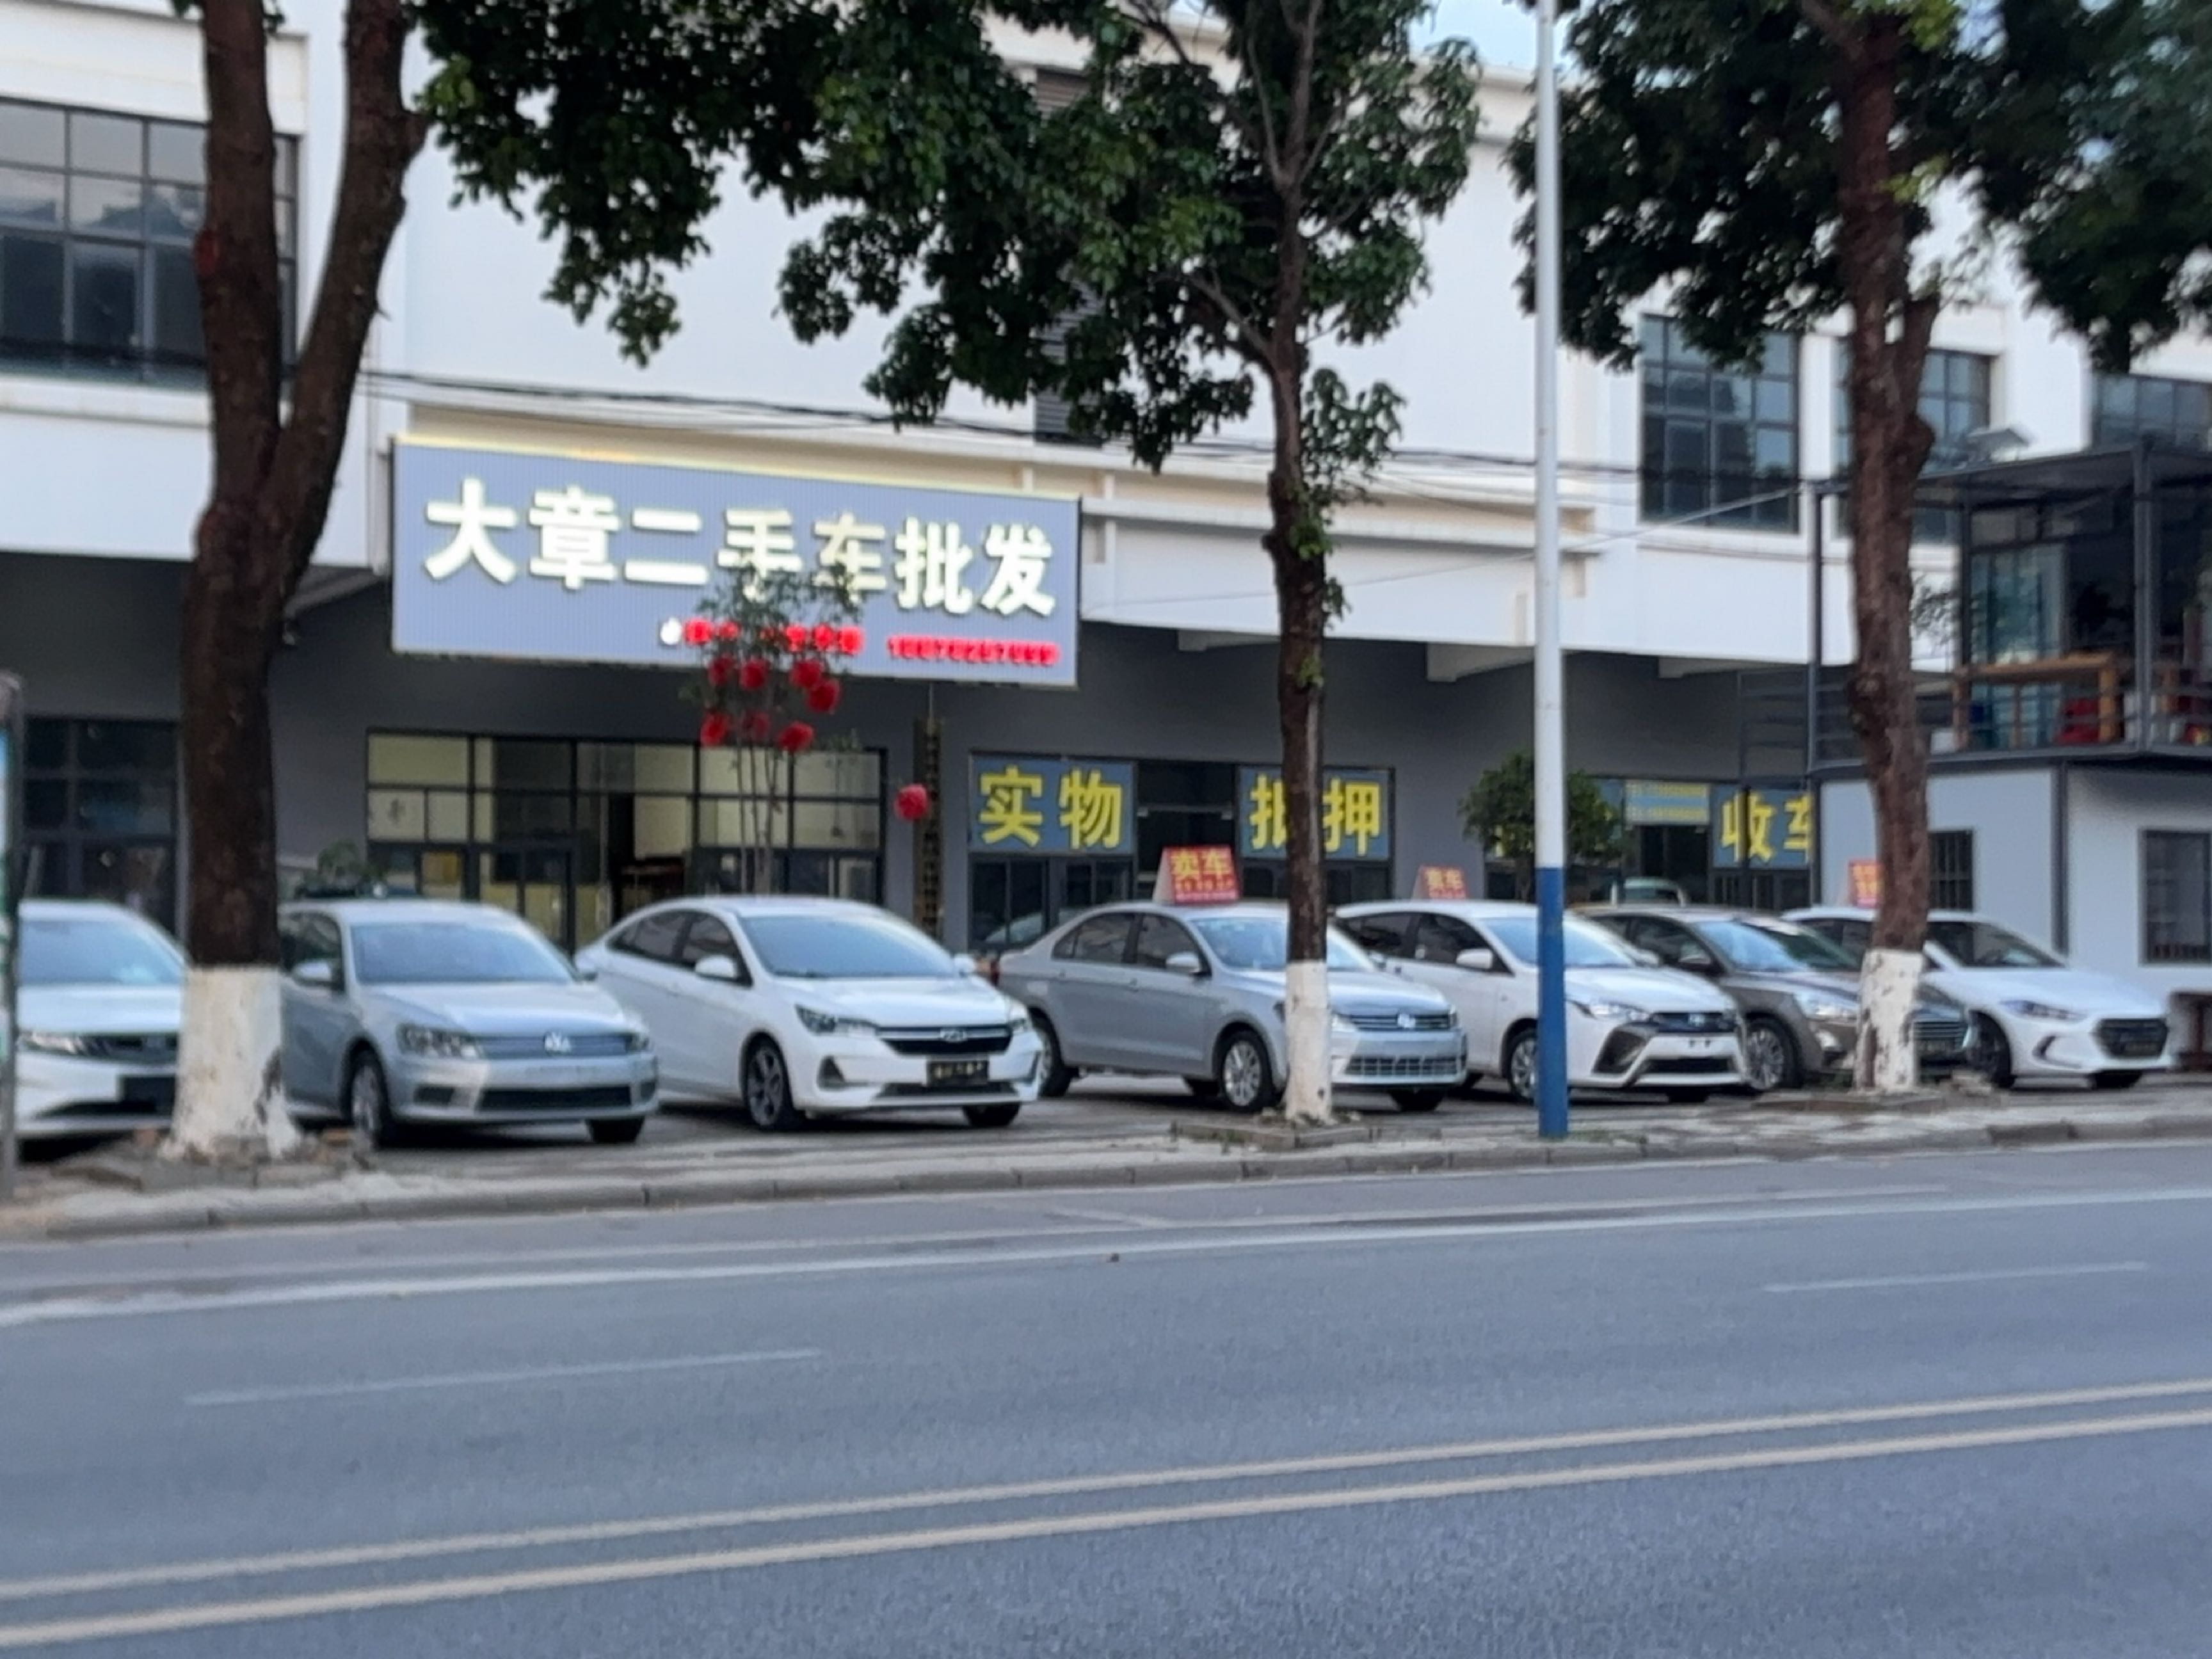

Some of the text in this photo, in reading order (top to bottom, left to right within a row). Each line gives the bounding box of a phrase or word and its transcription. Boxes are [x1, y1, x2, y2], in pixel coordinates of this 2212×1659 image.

[424, 477, 1056, 616] 大章二手车批发
[979, 765, 1123, 849] 实物
